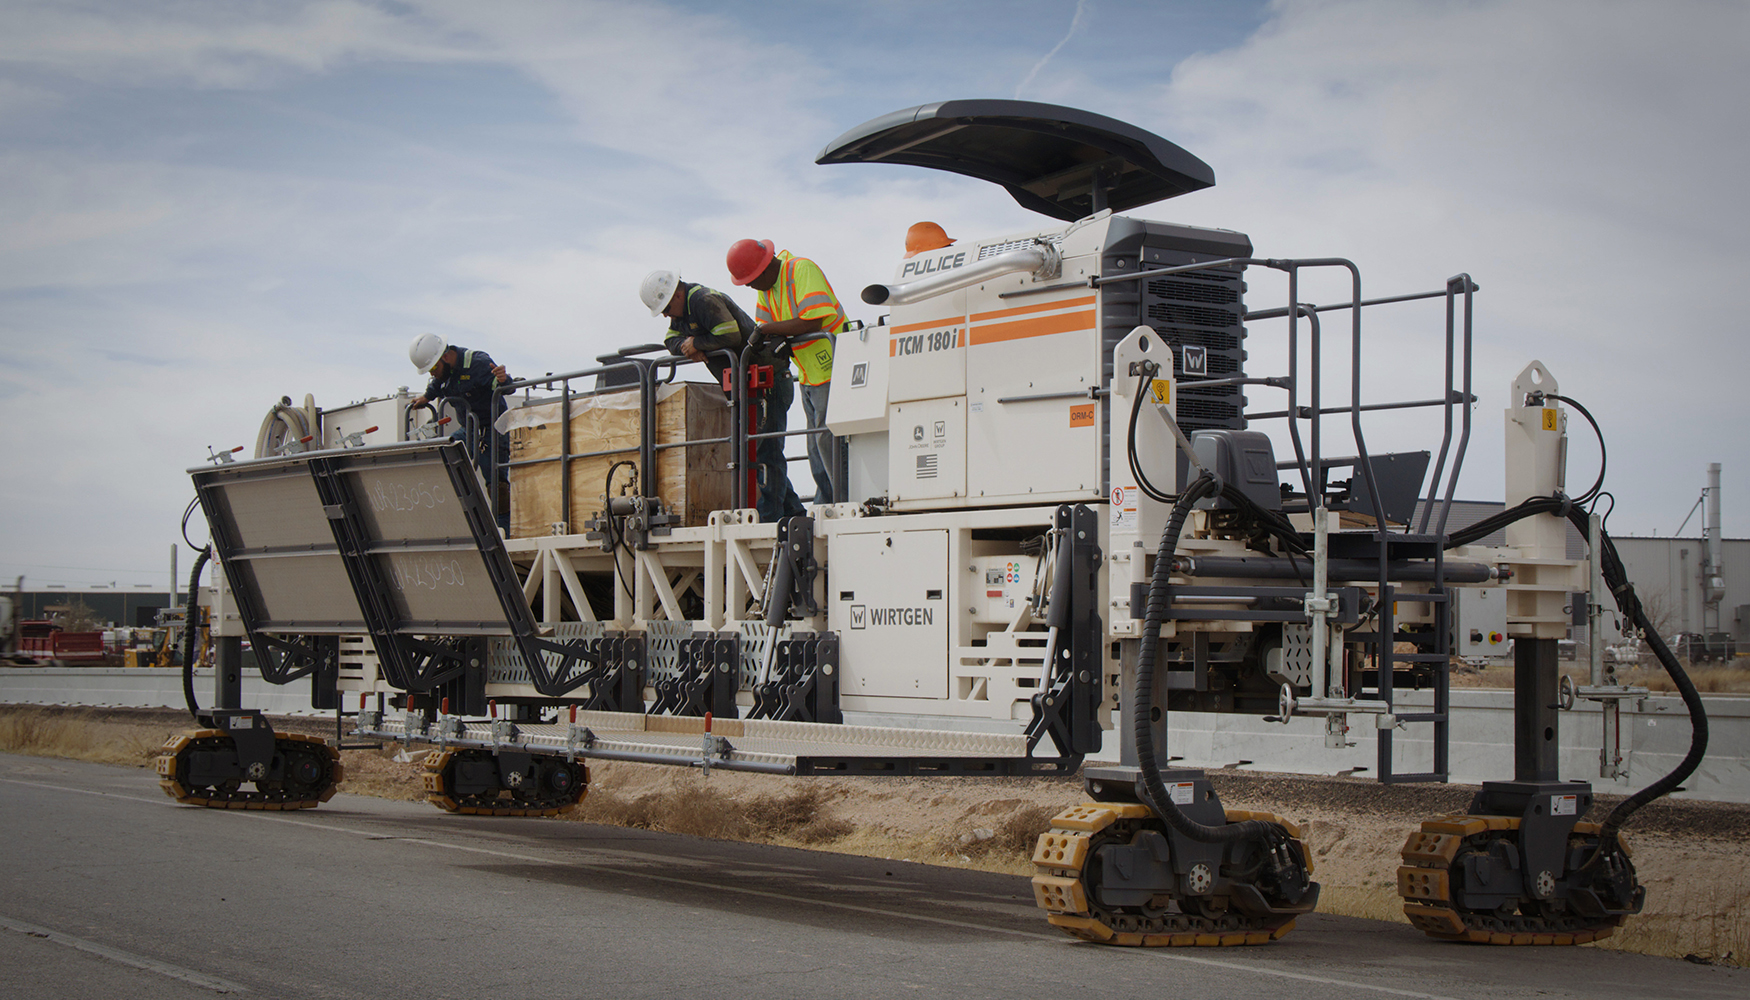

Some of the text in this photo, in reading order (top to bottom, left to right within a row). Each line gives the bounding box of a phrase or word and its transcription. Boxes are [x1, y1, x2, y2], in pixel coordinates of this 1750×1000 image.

[902, 252, 966, 278] PULICE
[899, 334, 924, 356] TCM
[1071, 411, 1094, 421] ORM-C
[870, 607, 933, 626] WIRTGEN
